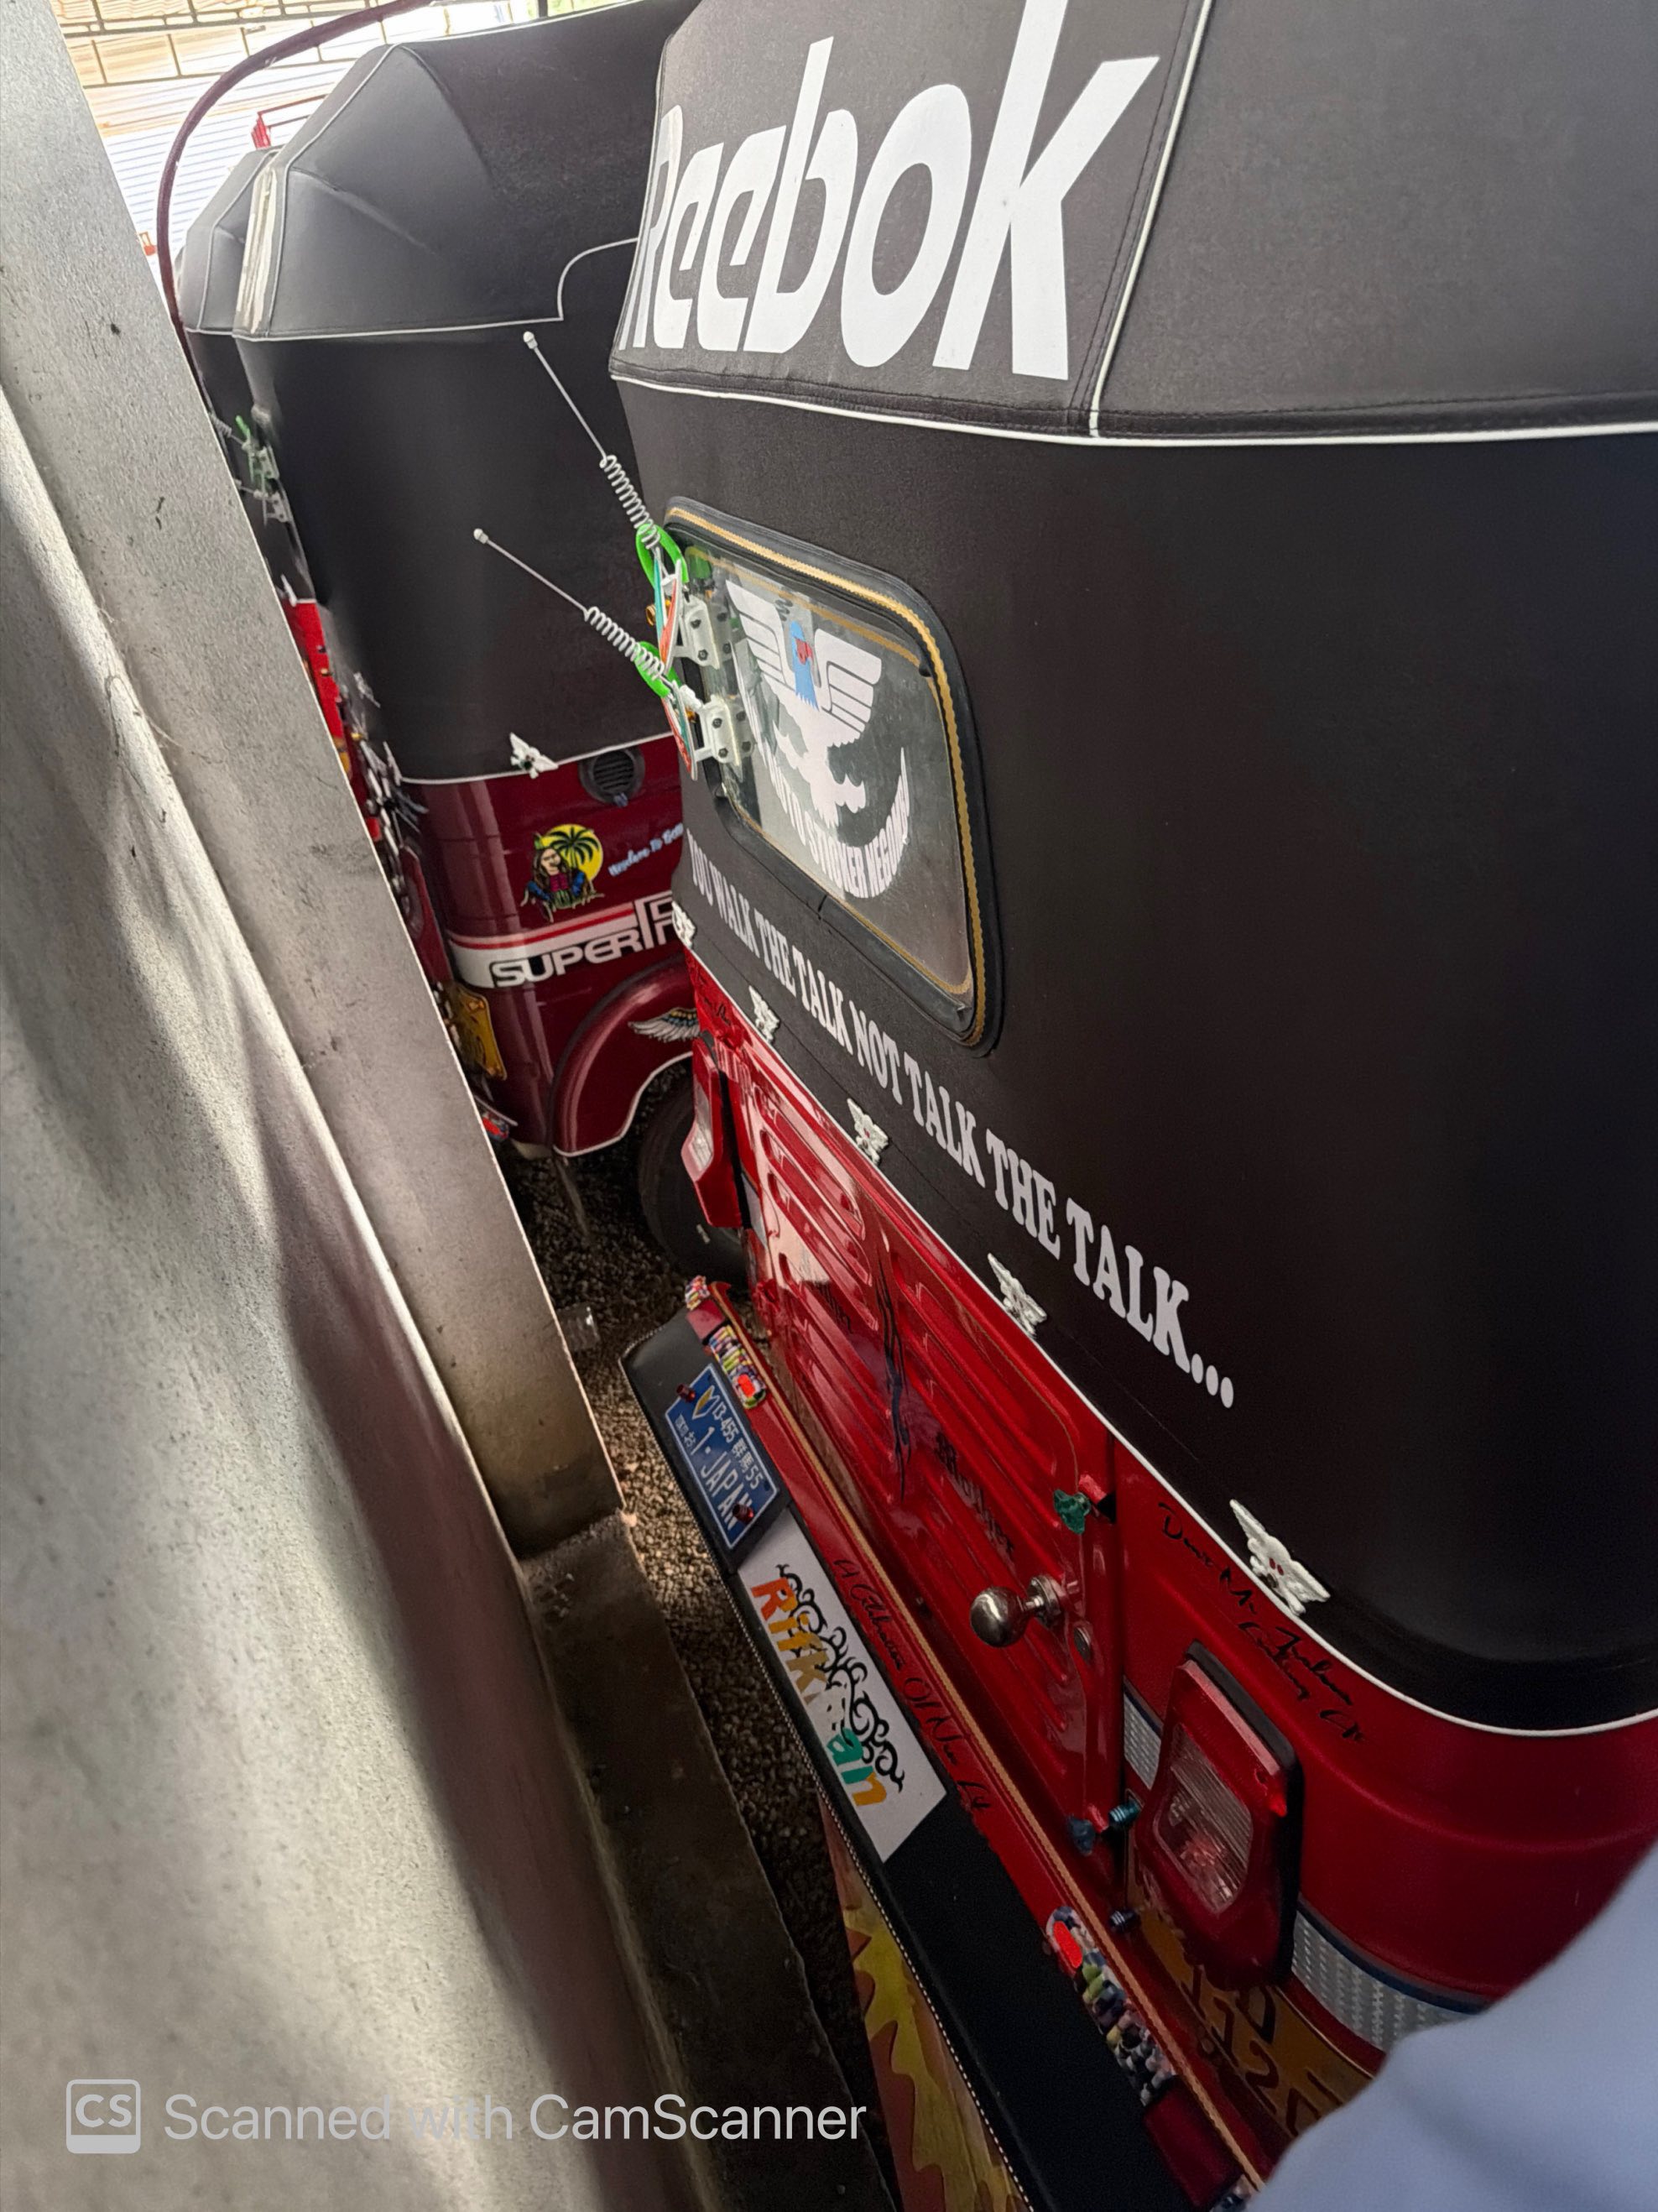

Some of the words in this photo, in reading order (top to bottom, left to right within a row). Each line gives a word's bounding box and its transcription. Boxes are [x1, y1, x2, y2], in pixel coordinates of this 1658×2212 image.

[618, 0, 1160, 380] Reebok
[804, 810, 869, 898] STICKER
[708, 859, 760, 958] WALK
[754, 907, 796, 998] THE
[792, 944, 853, 1056] TALK
[848, 999, 903, 1106] NOT
[904, 1051, 986, 1189] TALK
[985, 1127, 1061, 1260] THE
[1066, 1197, 1234, 1409] TALK...
